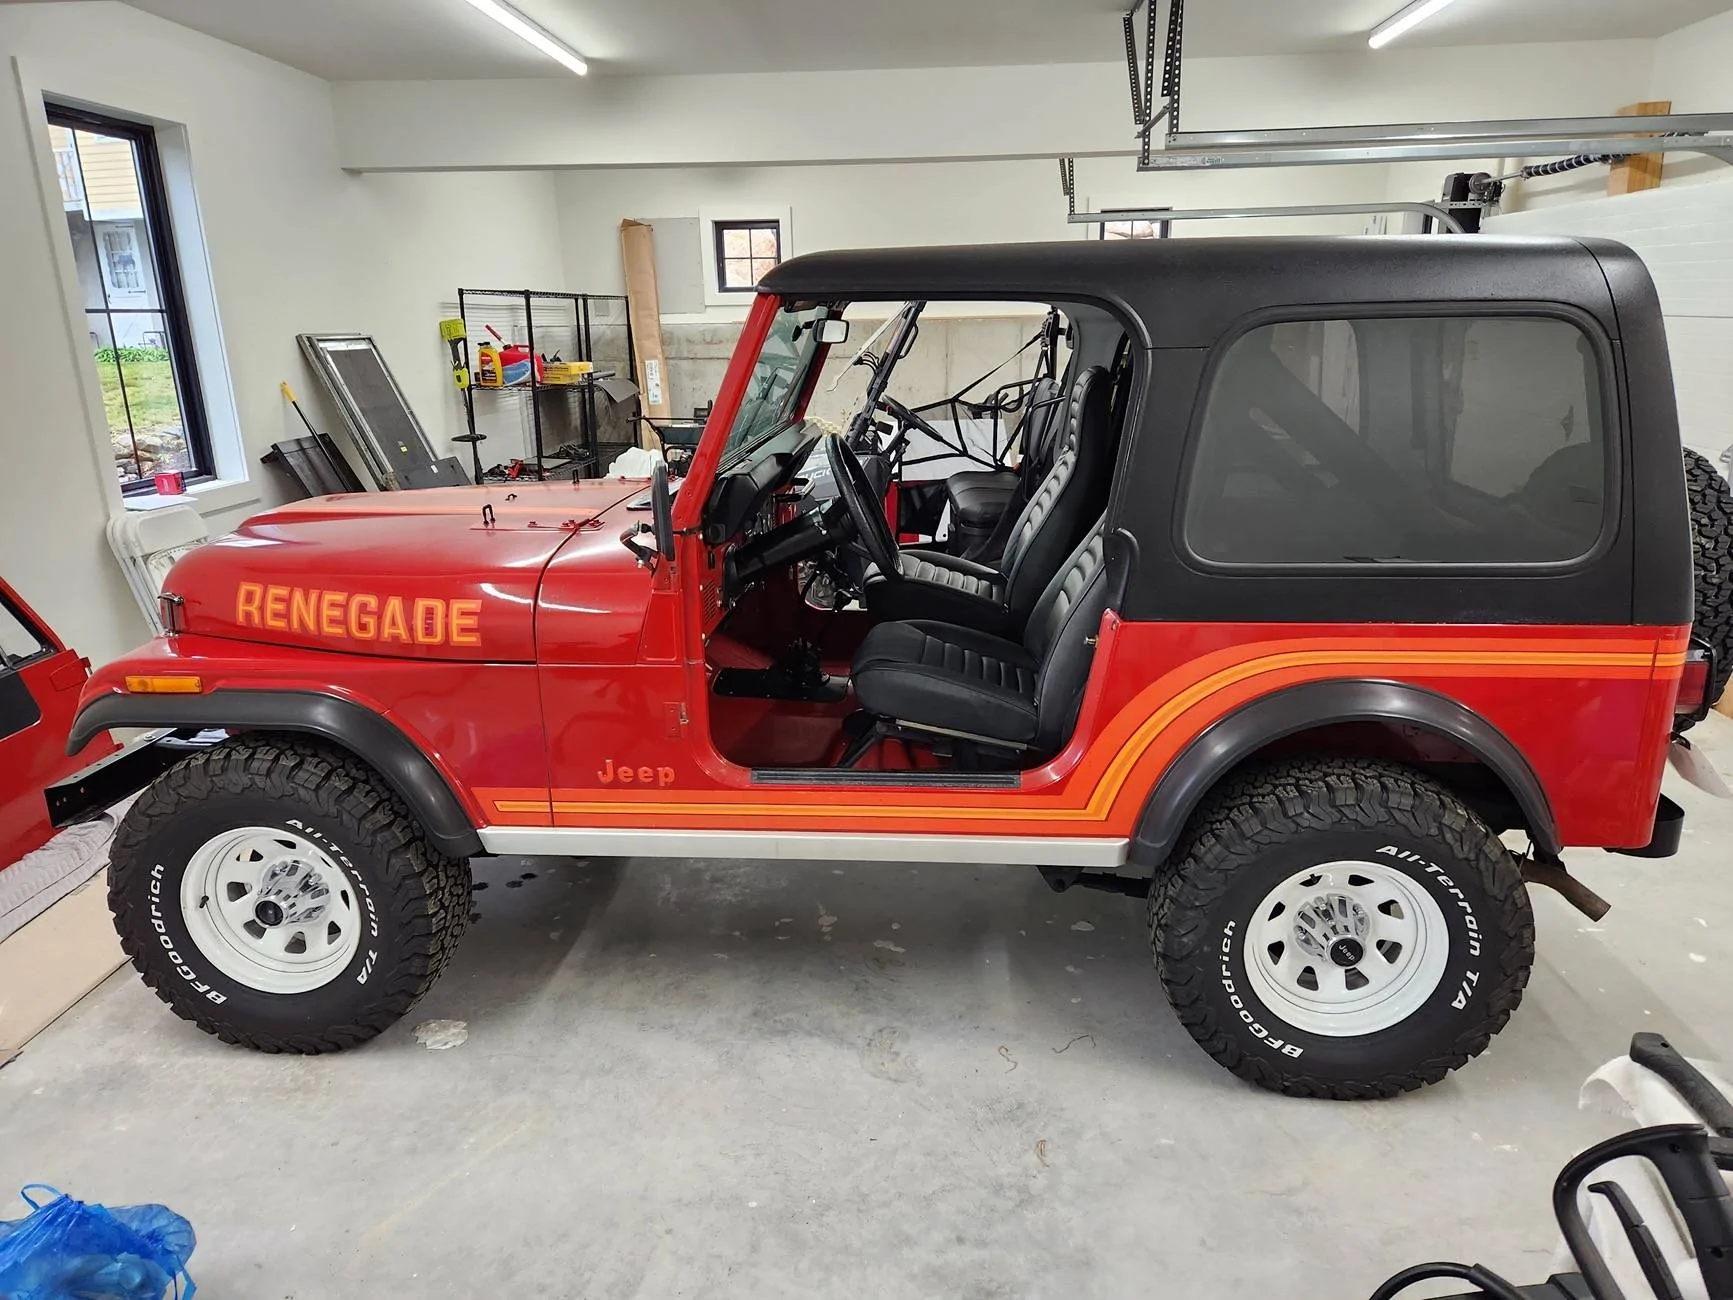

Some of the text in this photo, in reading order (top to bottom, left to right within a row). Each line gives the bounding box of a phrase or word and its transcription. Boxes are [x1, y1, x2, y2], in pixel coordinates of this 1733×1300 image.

[236, 581, 482, 647] RENEGADE
[597, 759, 675, 787] Jeep
[148, 864, 228, 1005] BFGoodrich
[285, 819, 379, 985] All-Terrain T/A
[1338, 944, 1356, 961] Jeep
[1375, 845, 1482, 1010] All-Terrain T/A
[1219, 920, 1304, 1058] BFGoodrich
